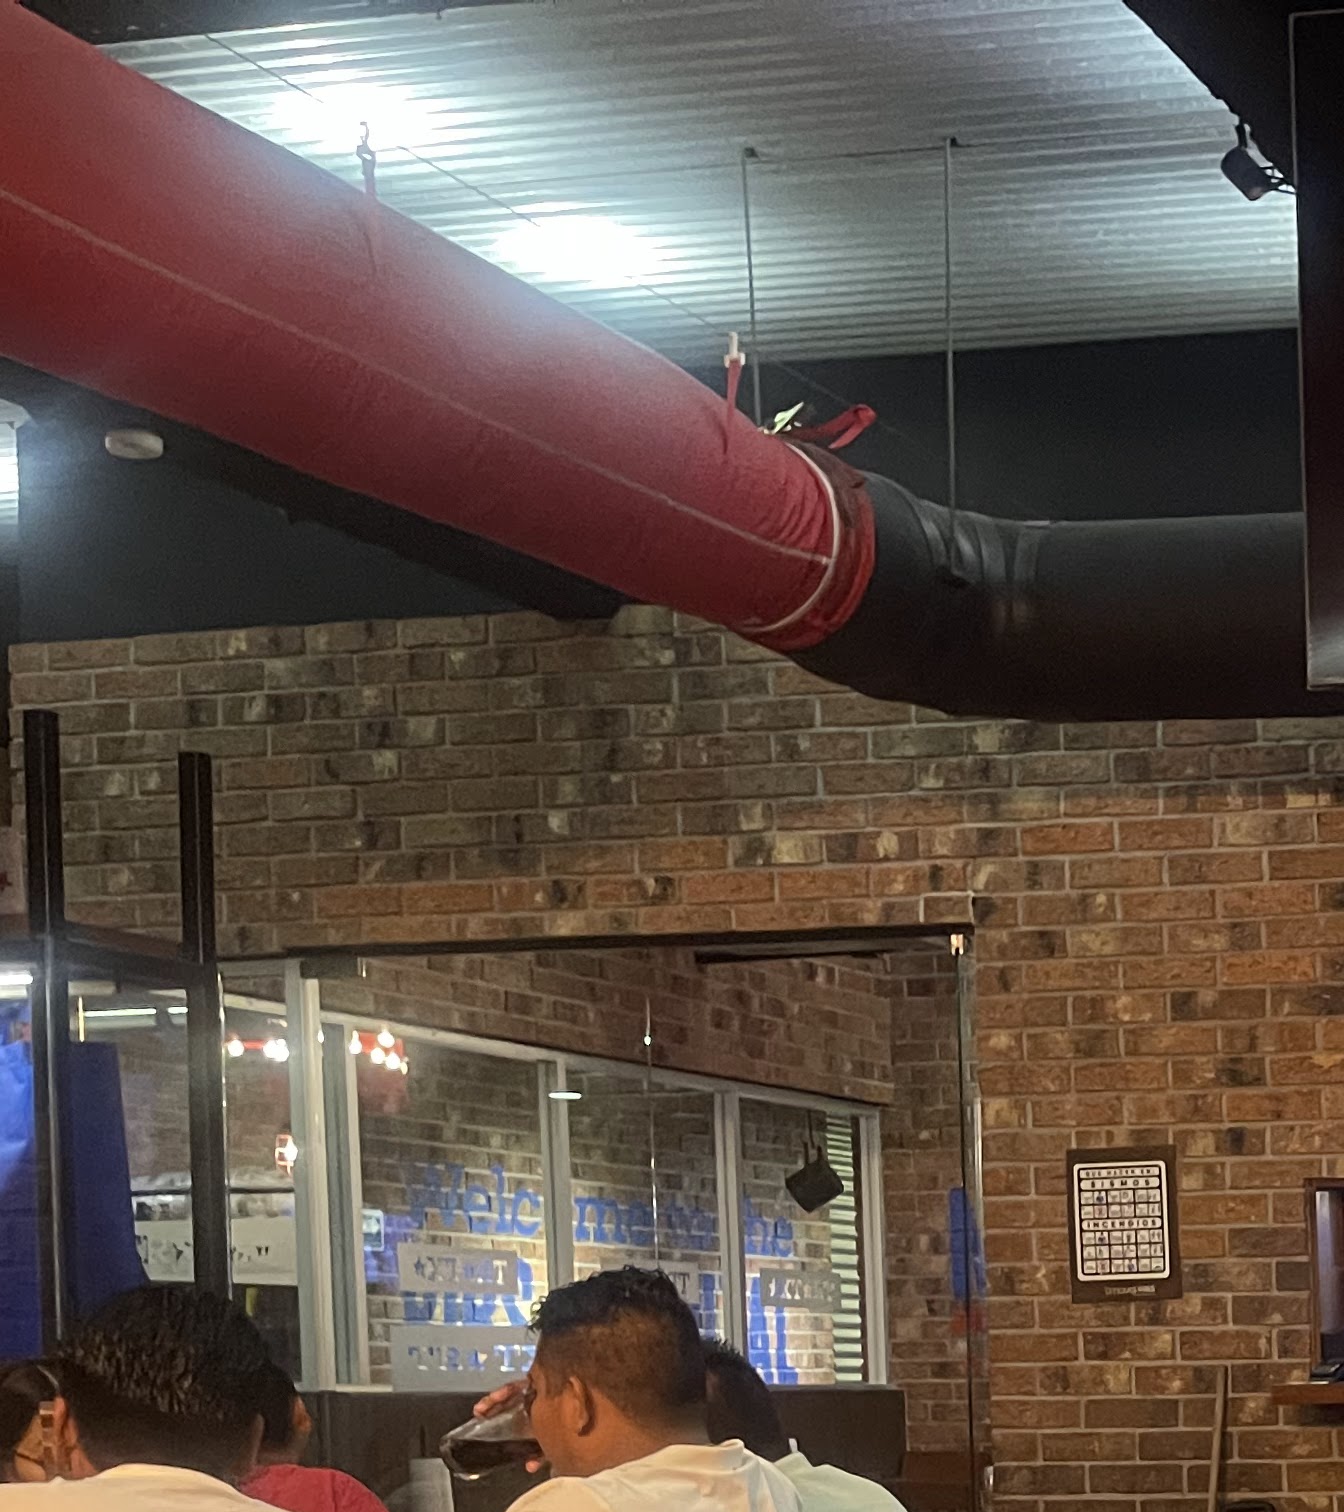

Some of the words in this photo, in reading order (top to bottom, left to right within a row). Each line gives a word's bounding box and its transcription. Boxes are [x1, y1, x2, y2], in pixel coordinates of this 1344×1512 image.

[1090, 1178, 1151, 1189] SISMOS
[742, 1193, 794, 1258] he
[1086, 1218, 1157, 1229] INCENDIOS
